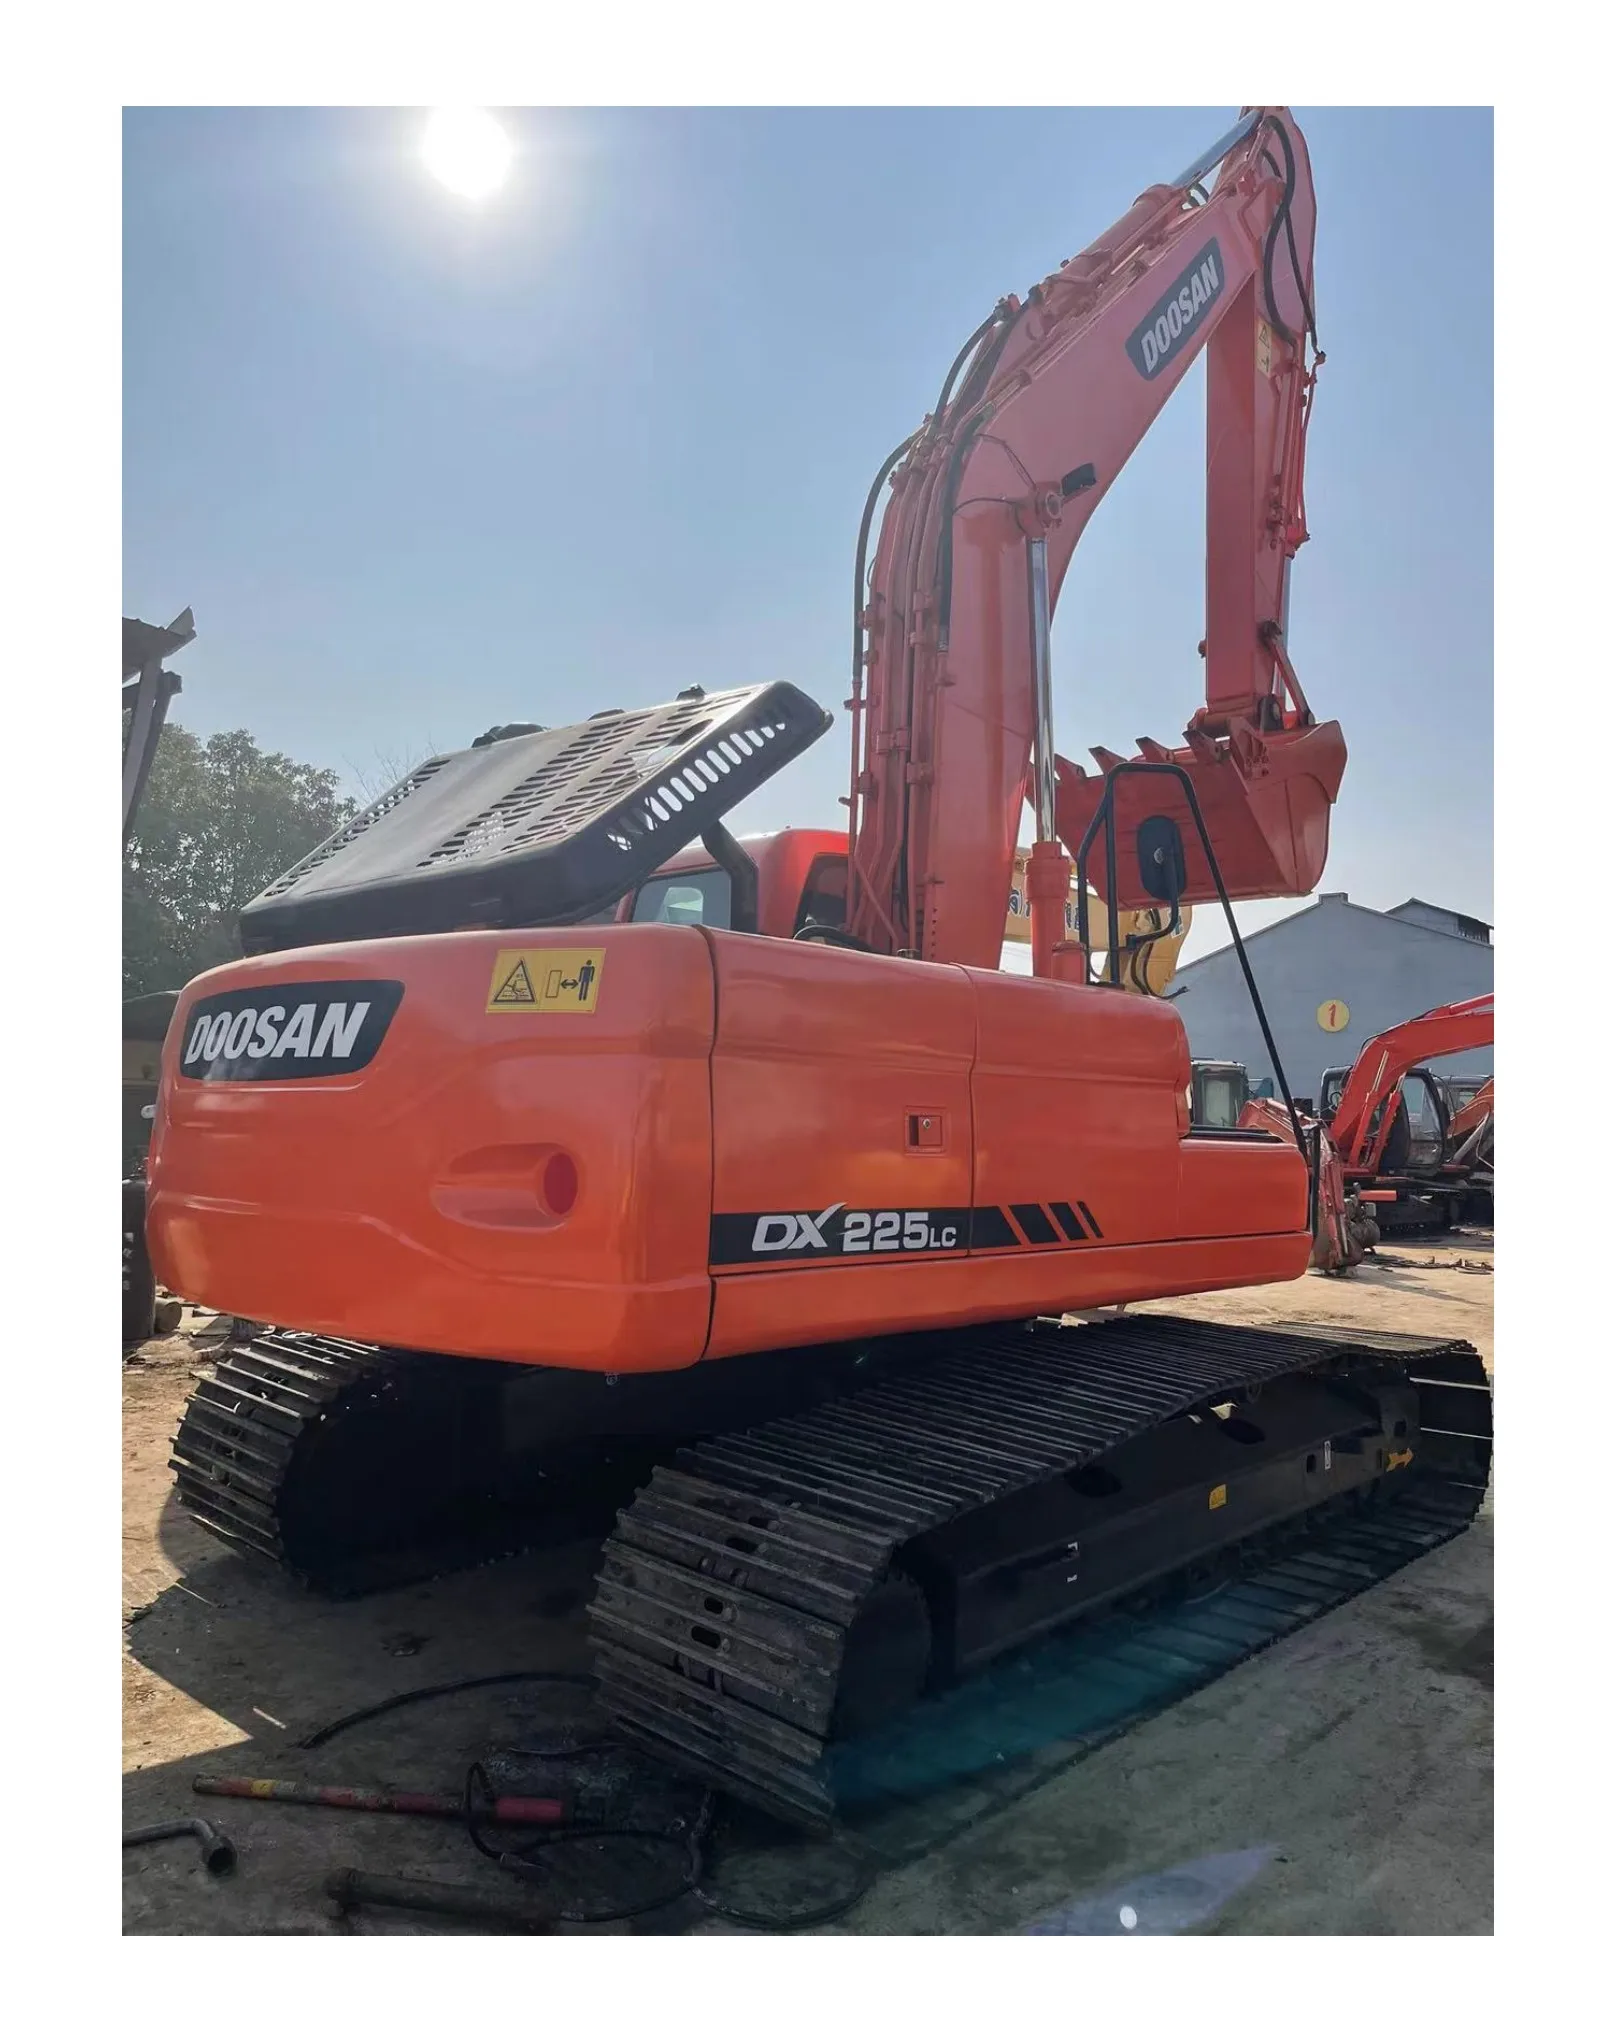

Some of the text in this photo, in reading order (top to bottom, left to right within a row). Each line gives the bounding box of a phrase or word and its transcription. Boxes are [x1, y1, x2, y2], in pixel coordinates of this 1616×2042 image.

[1141, 254, 1219, 373] DOOSAN
[184, 1002, 371, 1065] DOOSAN
[1328, 1003, 1336, 1028] 1
[751, 1201, 847, 1251] DX
